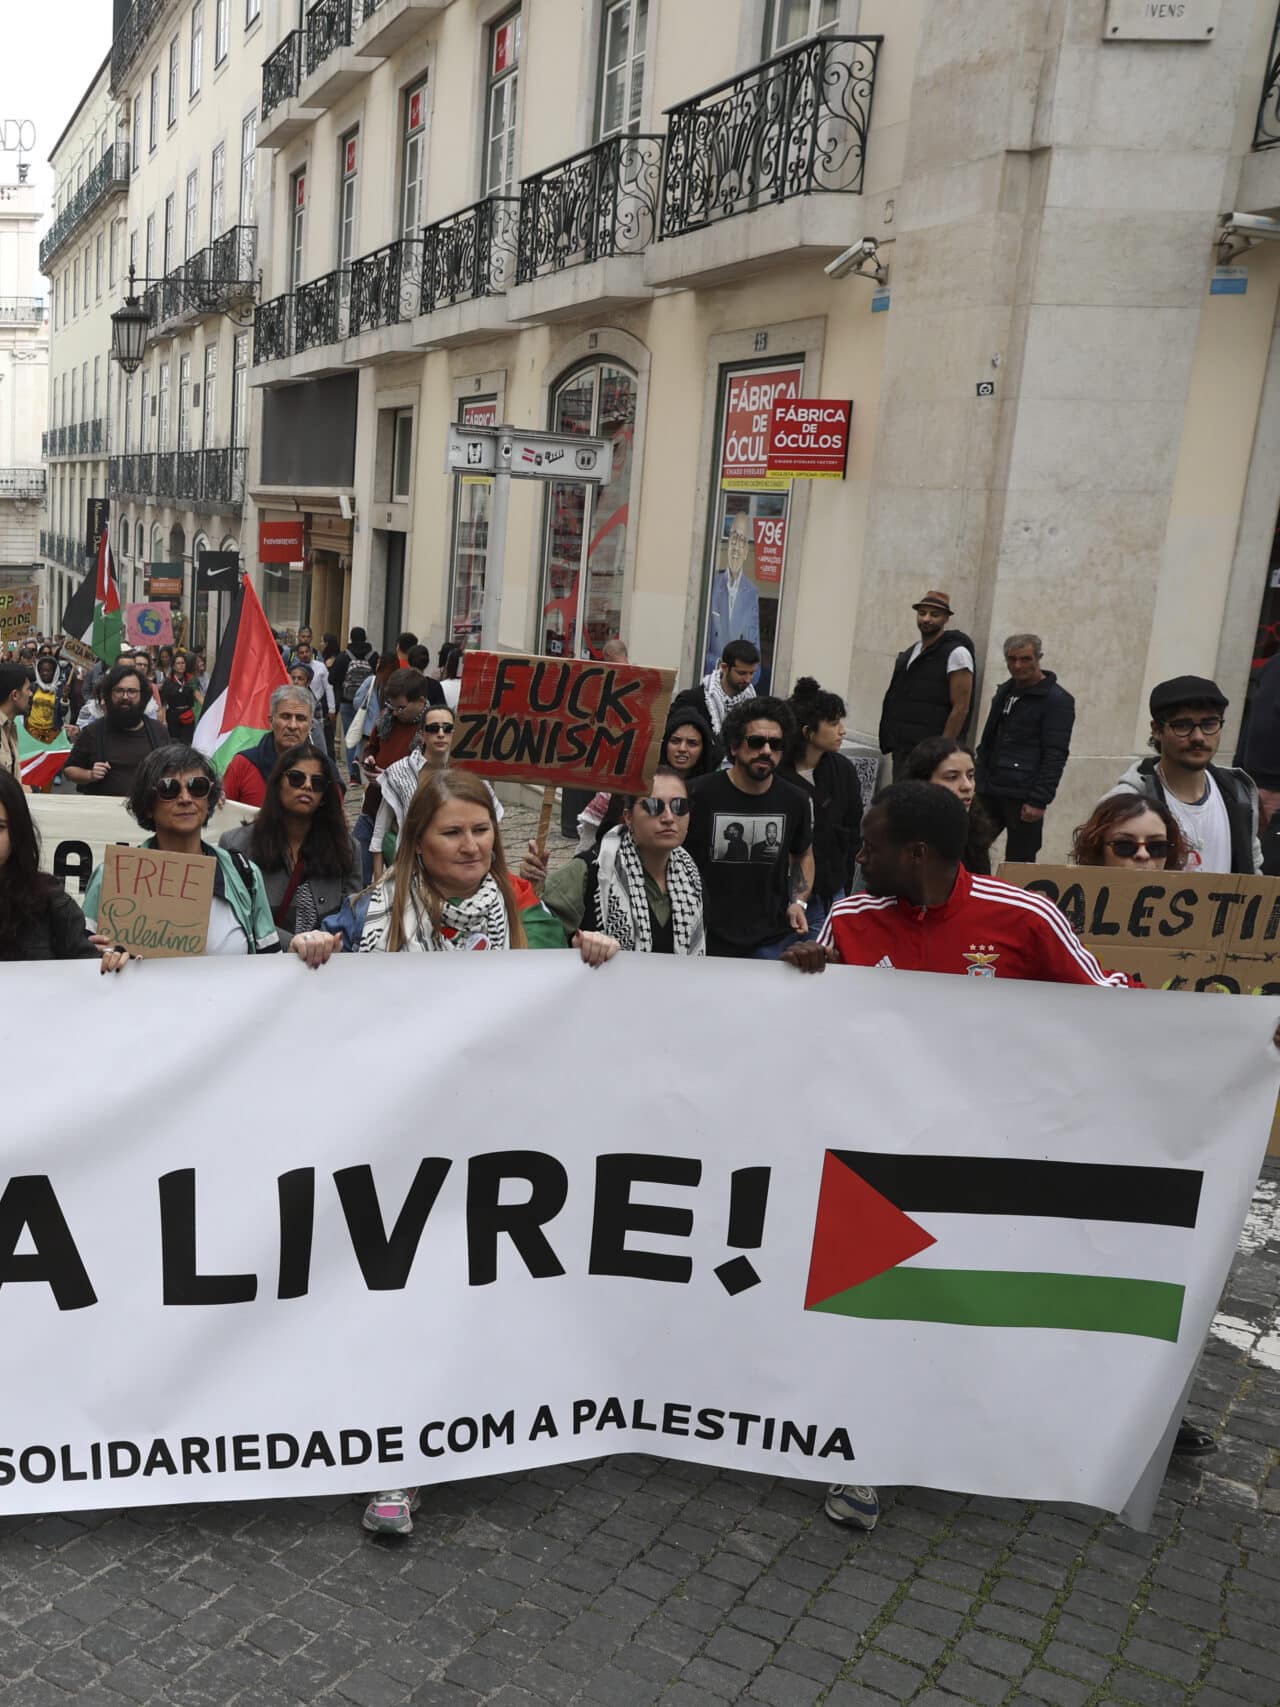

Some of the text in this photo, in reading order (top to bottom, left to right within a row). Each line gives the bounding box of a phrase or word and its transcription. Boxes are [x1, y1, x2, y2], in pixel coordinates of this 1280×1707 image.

[1145, 4, 1185, 18] IVENS
[752, 414, 768, 432] DE
[775, 405, 846, 422] FÁBRICA
[802, 423, 818, 433] DE
[726, 430, 767, 462] ÓCUL
[774, 430, 842, 448] ÓCULOS
[757, 521, 784, 545] 79€
[491, 658, 641, 725] FUCK
[451, 713, 636, 776] ZIONISM
[115, 854, 206, 901] FREE
[99, 897, 204, 954] Palestine
[159, 1150, 772, 1306] LIVRE!
[420, 1410, 515, 1458] COM
[529, 1405, 559, 1441] A
[573, 1396, 856, 1461] PALESTINA
